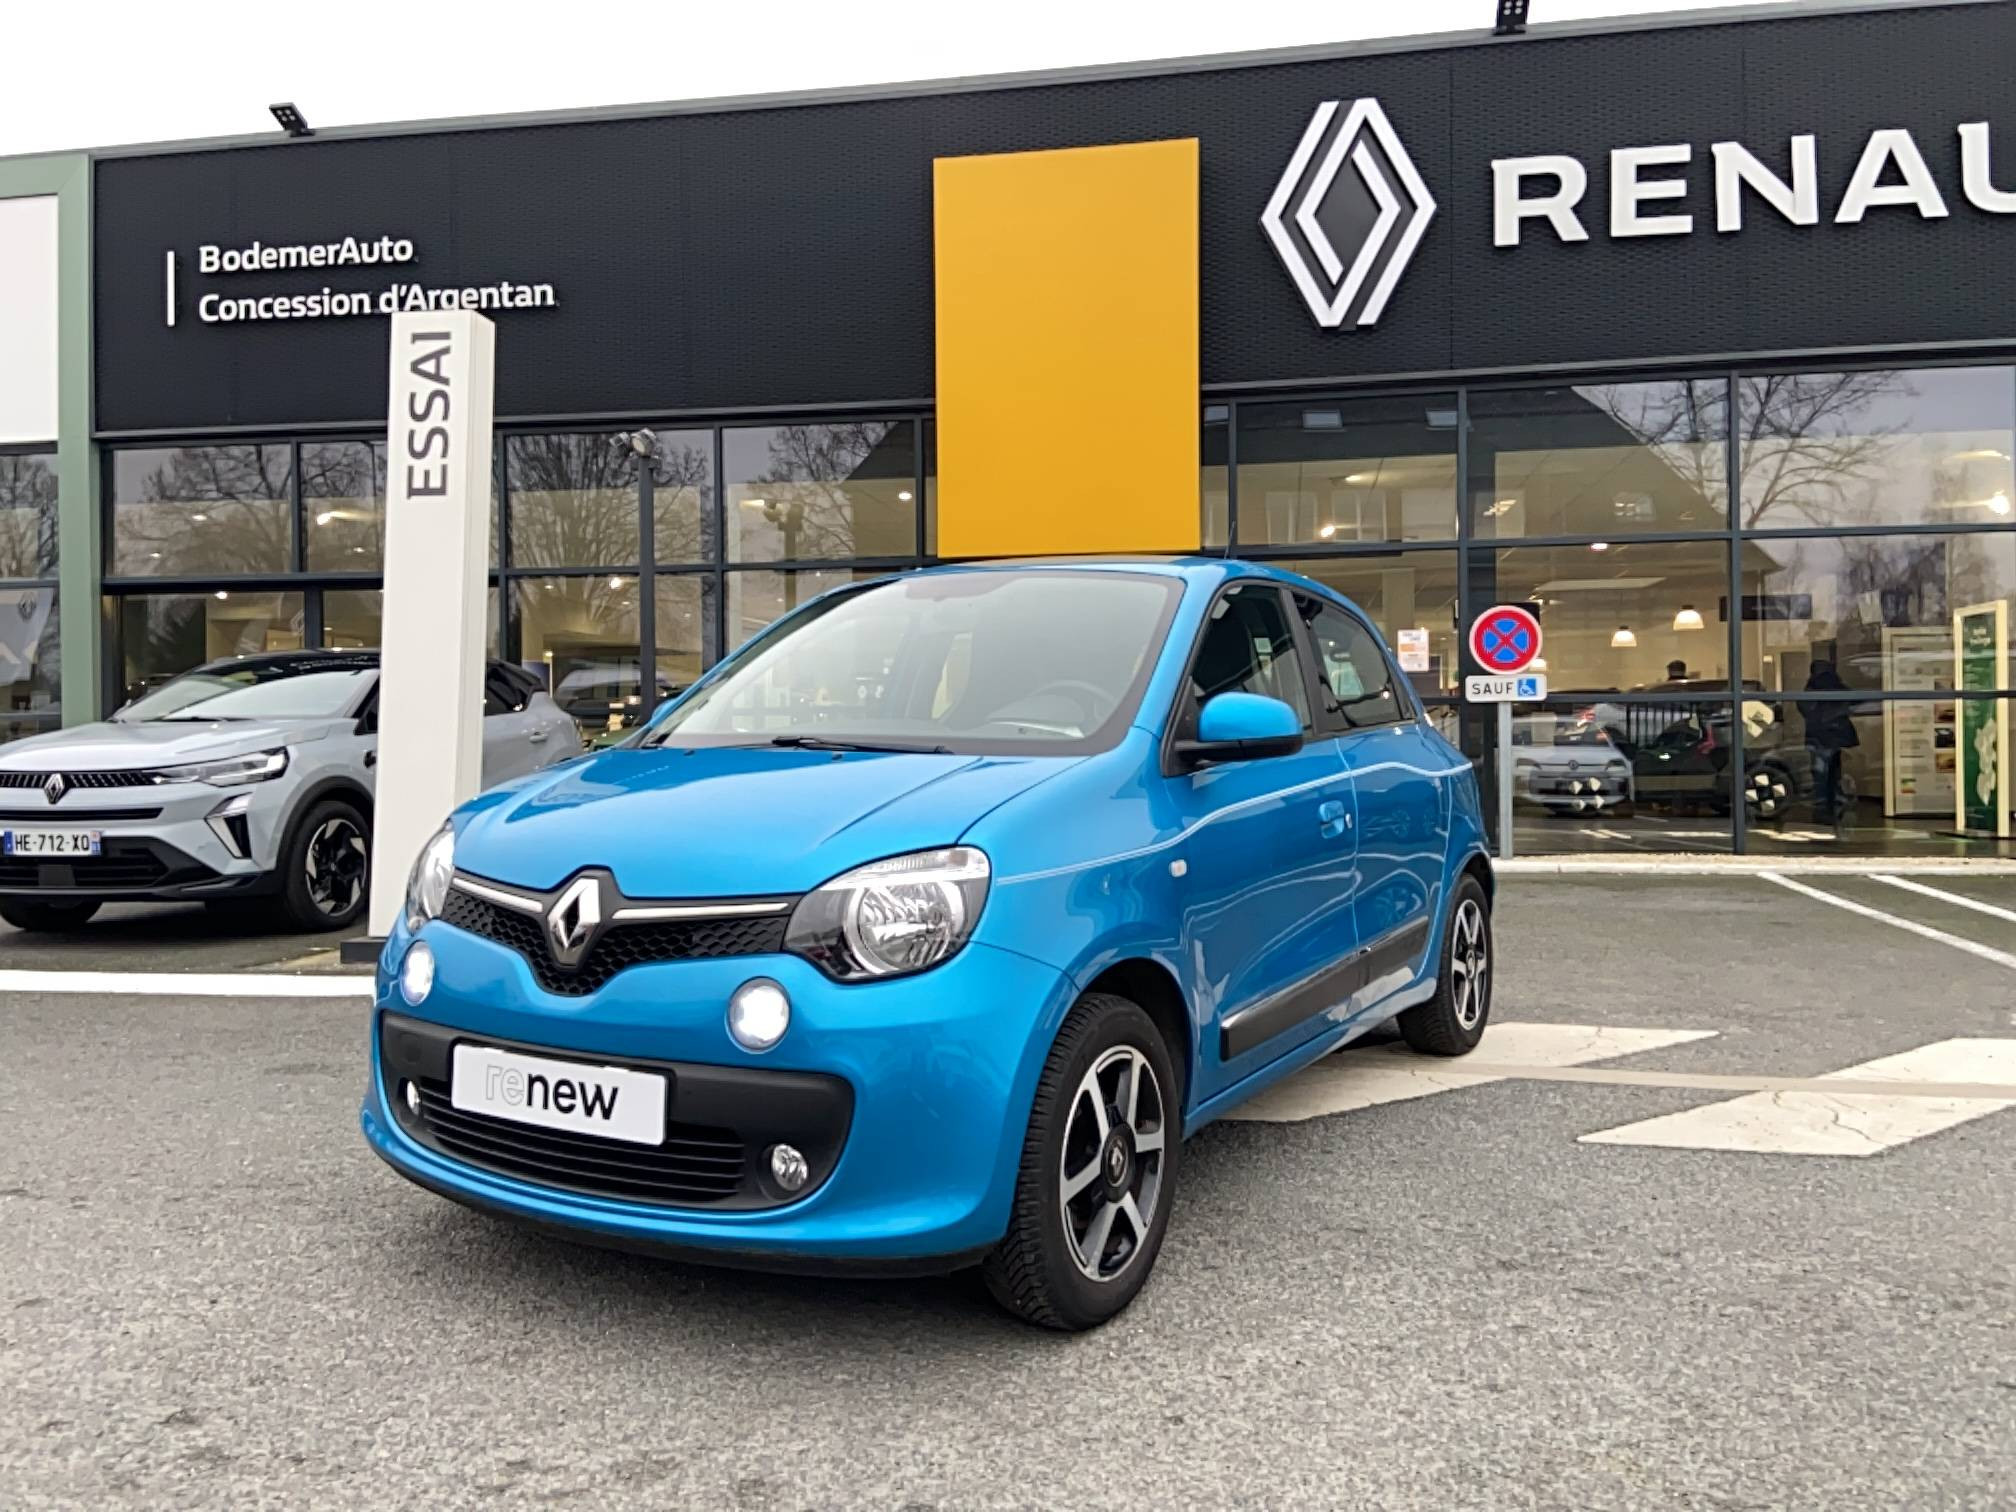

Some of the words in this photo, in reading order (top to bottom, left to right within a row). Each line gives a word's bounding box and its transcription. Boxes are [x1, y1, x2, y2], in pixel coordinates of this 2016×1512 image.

[199, 236, 414, 274] BodemerAuto
[199, 287, 372, 323] Concession
[406, 331, 452, 499] ESSAI
[1471, 681, 1514, 696] SAUF
[485, 1063, 620, 1121] renew
